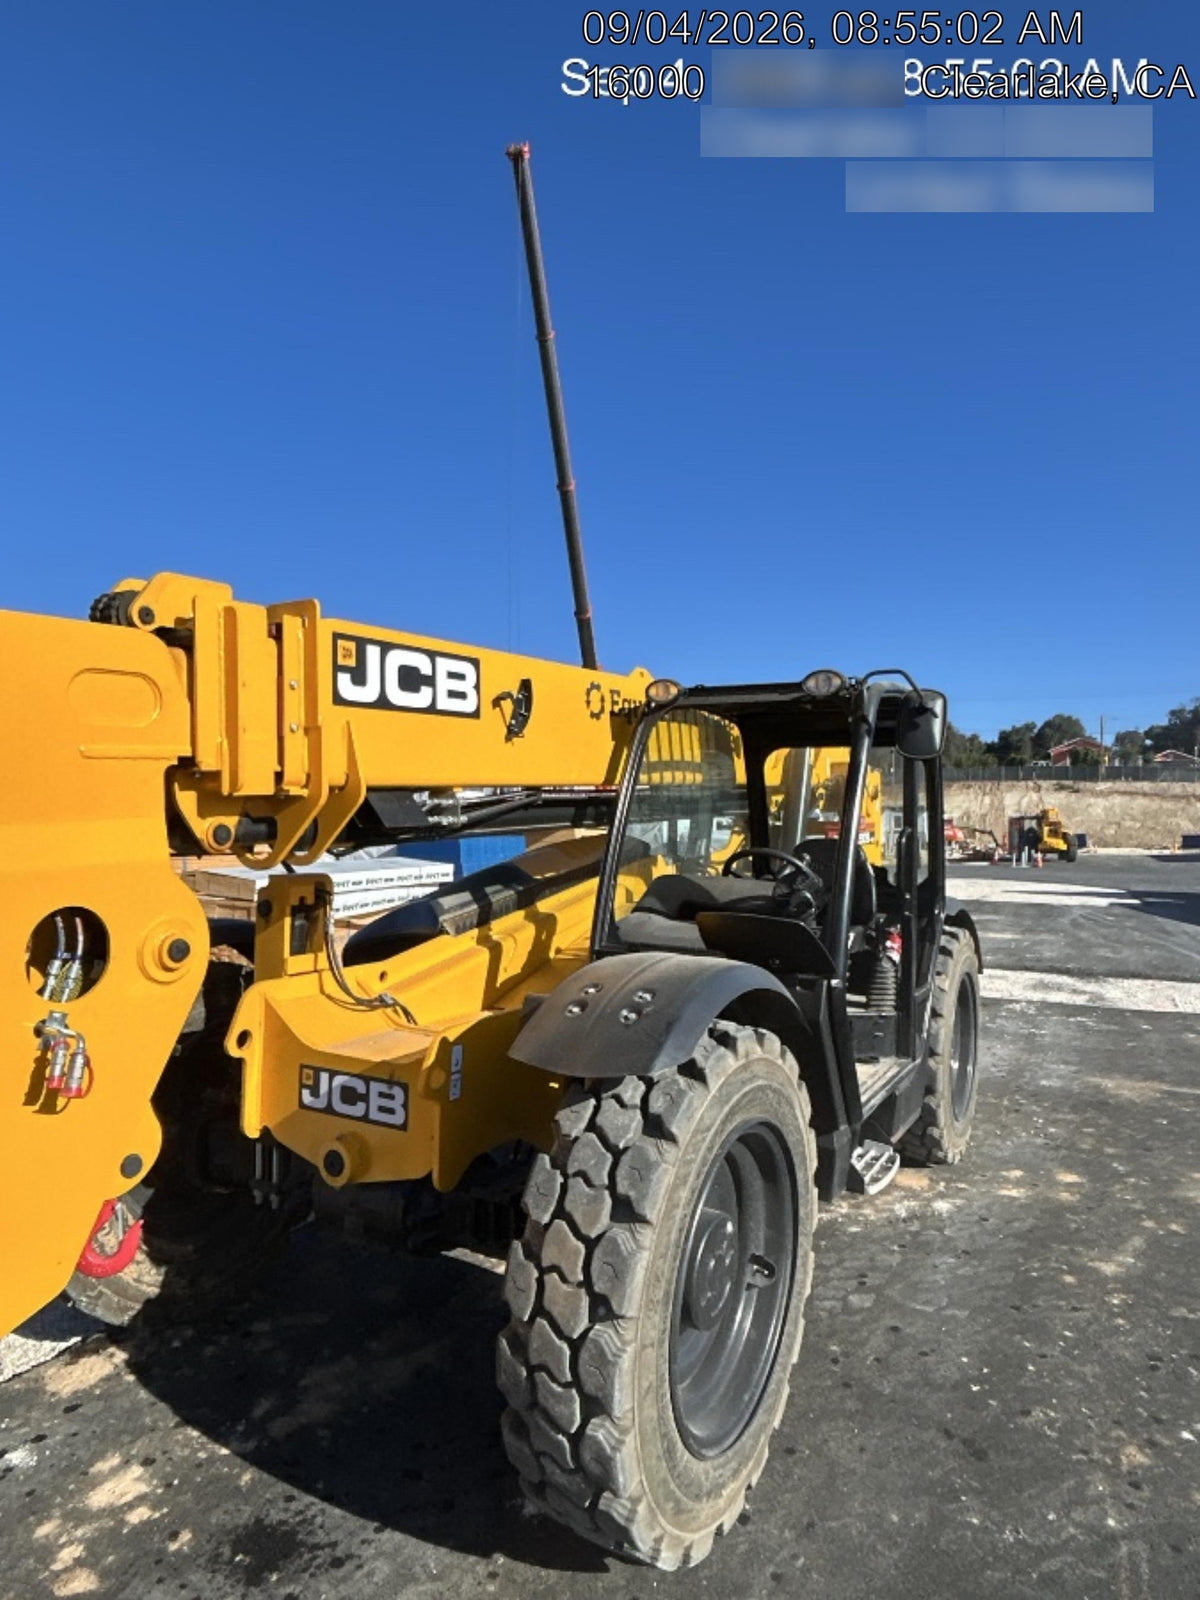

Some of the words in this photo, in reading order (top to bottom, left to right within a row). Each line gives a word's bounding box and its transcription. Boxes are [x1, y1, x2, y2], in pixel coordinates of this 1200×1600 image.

[337, 643, 479, 714] JCB
[609, 689, 643, 724] Equ
[301, 1070, 407, 1126] JCB
